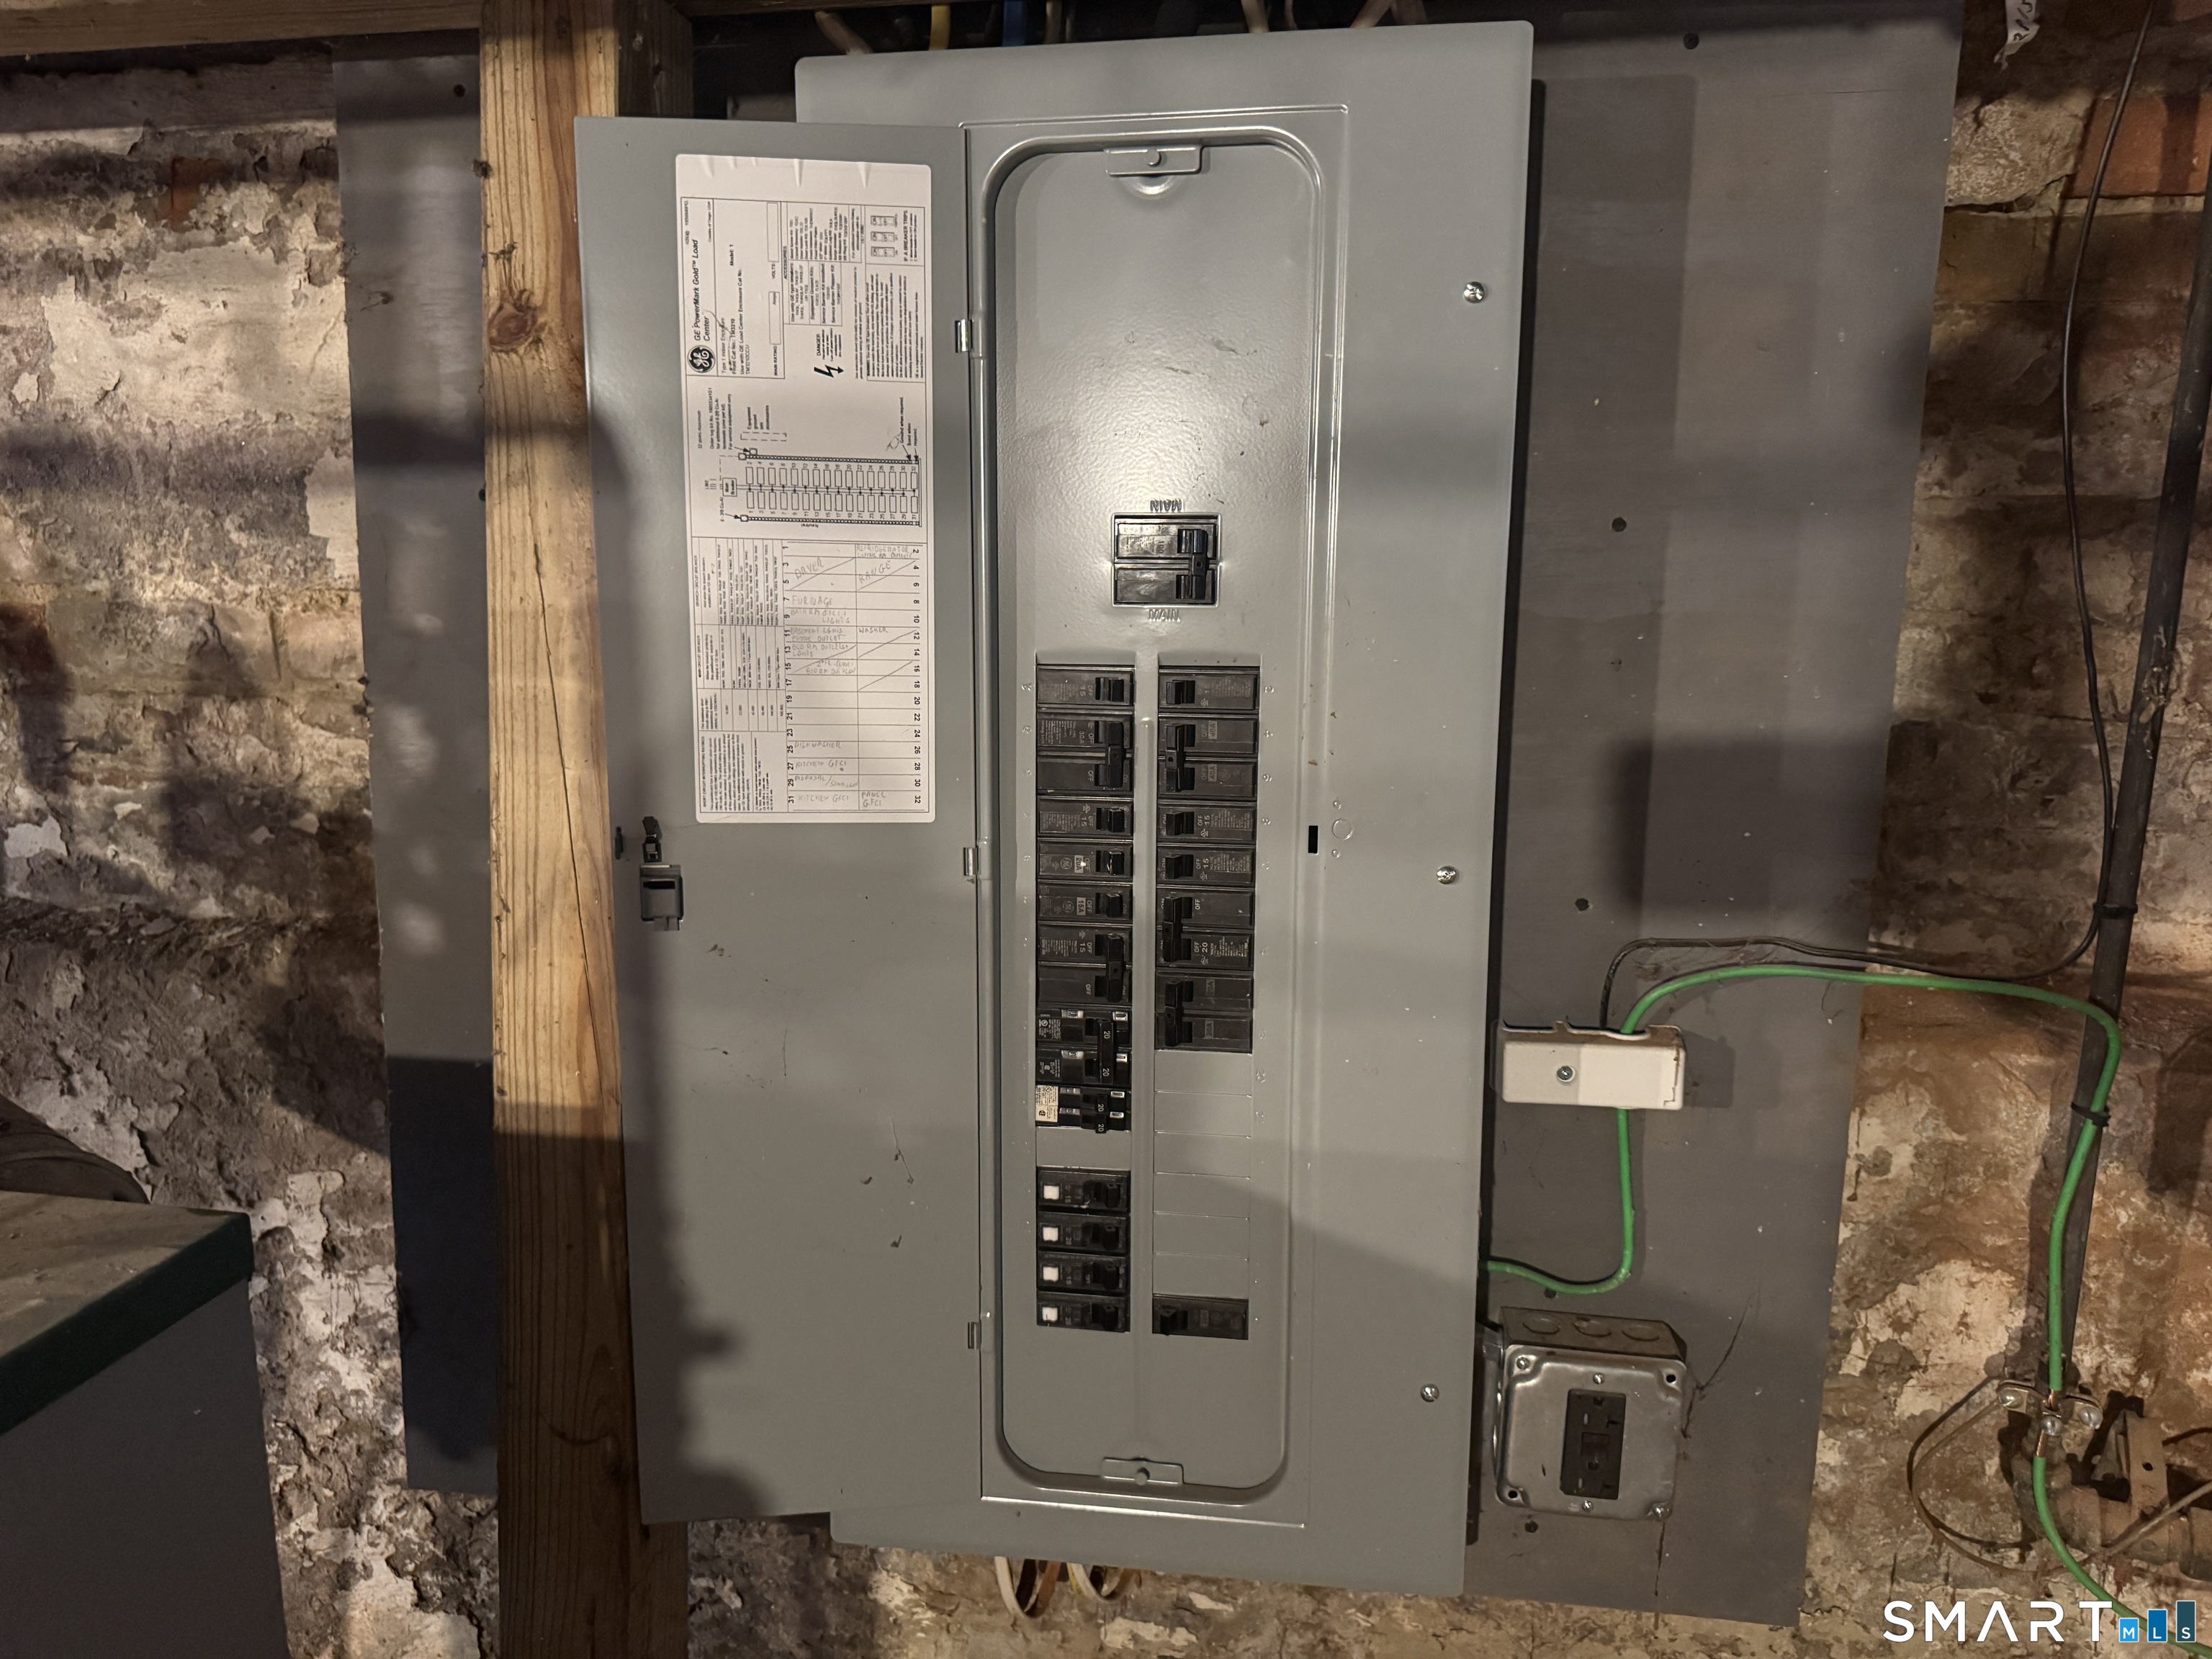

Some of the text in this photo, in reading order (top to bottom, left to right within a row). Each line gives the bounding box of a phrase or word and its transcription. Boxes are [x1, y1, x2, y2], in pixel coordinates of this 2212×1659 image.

[694, 330, 701, 341] GE
[739, 344, 744, 353] GE
[1150, 499, 1183, 512] MAIN
[794, 557, 825, 580] DRYER
[858, 560, 891, 584] RANGE
[914, 614, 920, 623] 10
[1148, 608, 1182, 622] MAIN
[914, 631, 920, 640] 12
[1079, 685, 1086, 696] 15
[828, 759, 847, 768] GFCI
[1081, 816, 1087, 827] 15
[1204, 814, 1210, 826] 15
[1202, 858, 1210, 869] 15
[1079, 942, 1086, 953] 15
[1202, 942, 1208, 953] 20
[1103, 1030, 1110, 1039] 20
[1102, 1068, 1110, 1076] 20
[1097, 1103, 1105, 1112] 20
[1098, 1123, 1105, 1132] 20
[1065, 1236, 1072, 1245] 20
